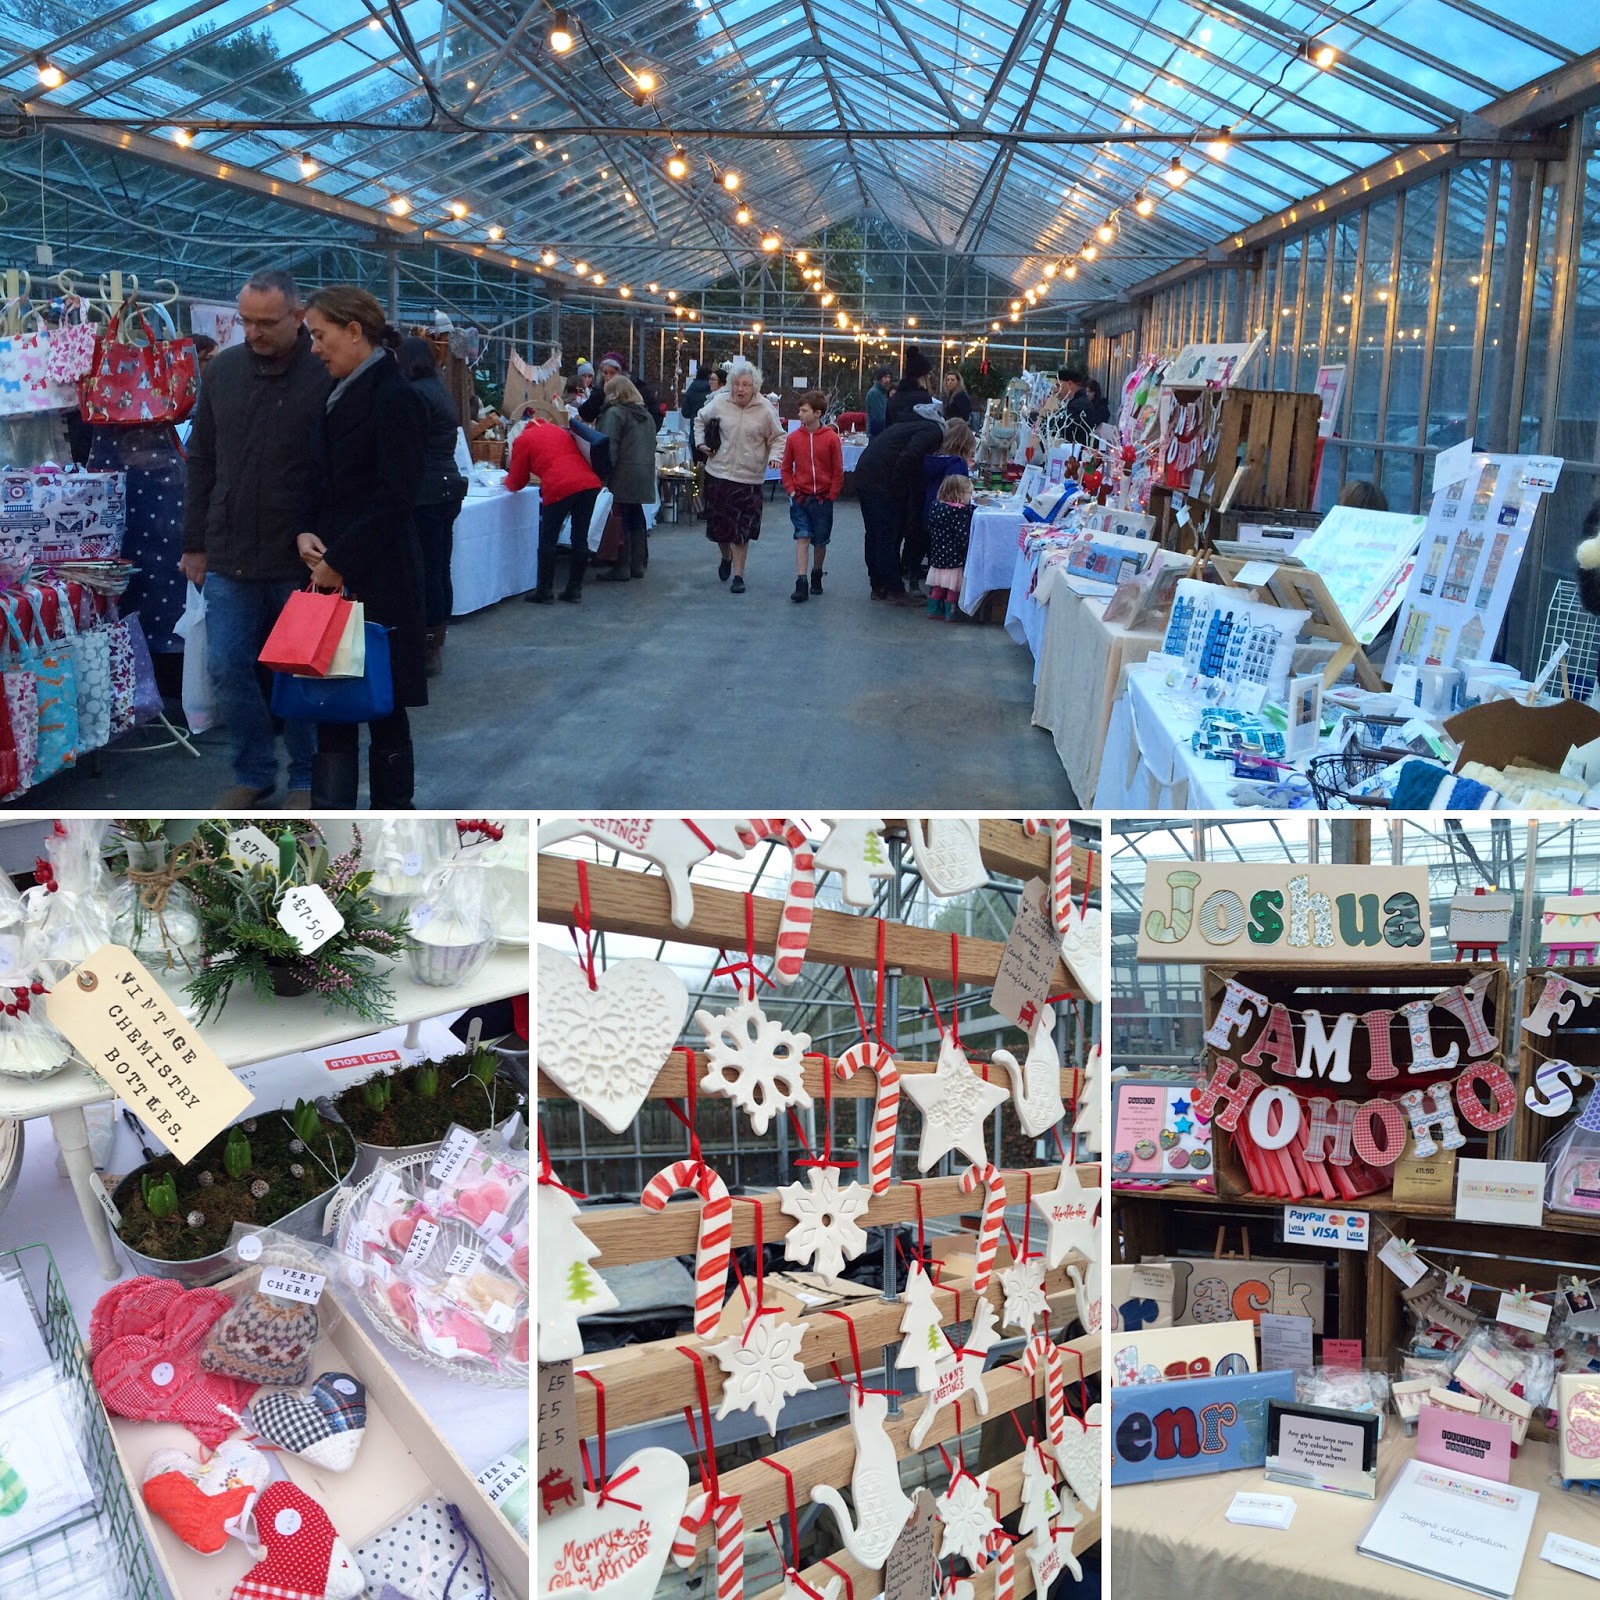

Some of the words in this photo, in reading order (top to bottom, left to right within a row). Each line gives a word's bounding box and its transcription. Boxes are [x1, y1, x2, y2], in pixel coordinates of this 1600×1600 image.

[578, 819, 646, 850] EETINGS
[293, 898, 325, 941] £7.50
[1145, 869, 1426, 948] Joshua
[1006, 944, 1024, 970] Candy
[120, 971, 197, 1064] VINTAGE
[1203, 971, 1500, 1083] FAMILY
[108, 1004, 201, 1109] CHEMISTRY
[330, 1057, 359, 1068] SOLD
[368, 1052, 395, 1062] SOLD
[104, 1047, 184, 1143] BOTTLES.
[435, 1138, 454, 1165] VERY
[441, 1138, 469, 1178] CHERRY
[1289, 1210, 1326, 1222] PayPal
[408, 1226, 422, 1254] VERY
[413, 1223, 435, 1266] CHERRY
[1311, 1226, 1339, 1239] VISA
[449, 1250, 462, 1267] VERY
[458, 1251, 477, 1274] CHERRY
[282, 1269, 317, 1282] VERY
[267, 1280, 321, 1298] CHERRY
[548, 1374, 567, 1393] £5
[939, 1366, 964, 1387] ASON'S
[538, 1400, 563, 1424] £5
[538, 1428, 566, 1452] £5
[1111, 1395, 1277, 1464] enry
[1287, 1429, 1299, 1437] Any
[1300, 1432, 1313, 1440] girls
[1322, 1435, 1336, 1444] boys
[1337, 1439, 1354, 1447] name
[1292, 1447, 1304, 1456] Any
[1305, 1449, 1324, 1458] colour
[1325, 1453, 1347, 1462] scheme
[1297, 1439, 1309, 1448] Any
[1310, 1441, 1329, 1450] colour
[1330, 1445, 1343, 1453] base
[1445, 1441, 1485, 1459] HANDMADE
[477, 1461, 506, 1485] VERY
[1303, 1457, 1316, 1466] Any
[1316, 1459, 1335, 1468] theme
[489, 1465, 526, 1501] HERRY
[1481, 1490, 1515, 1504] Designs
[1400, 1511, 1438, 1529] Designs
[1441, 1526, 1509, 1551] collaboration
[1429, 1531, 1455, 1546] book
[554, 1531, 616, 1573] Merry
